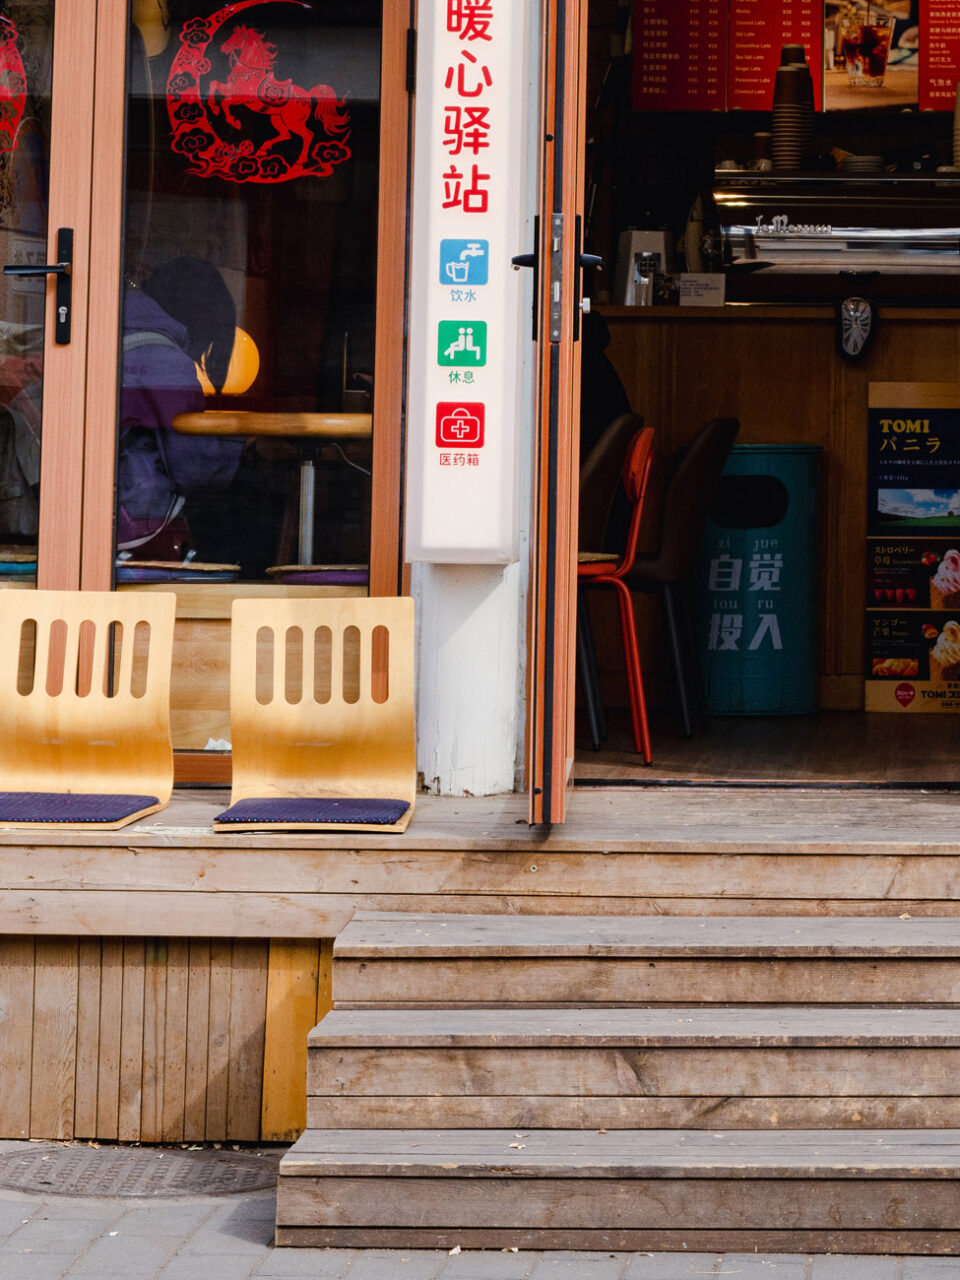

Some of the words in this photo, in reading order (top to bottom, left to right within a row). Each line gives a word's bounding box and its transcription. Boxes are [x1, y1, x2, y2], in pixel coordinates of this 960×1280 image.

[450, 289, 477, 303] 饮水
[448, 370, 475, 384] 休息
[879, 418, 931, 433] TOMI
[879, 436, 942, 454] バニラ
[439, 453, 480, 466] 医药箱
[753, 537, 779, 552] jue
[707, 553, 784, 592] 自觉
[707, 613, 784, 651] 投入
